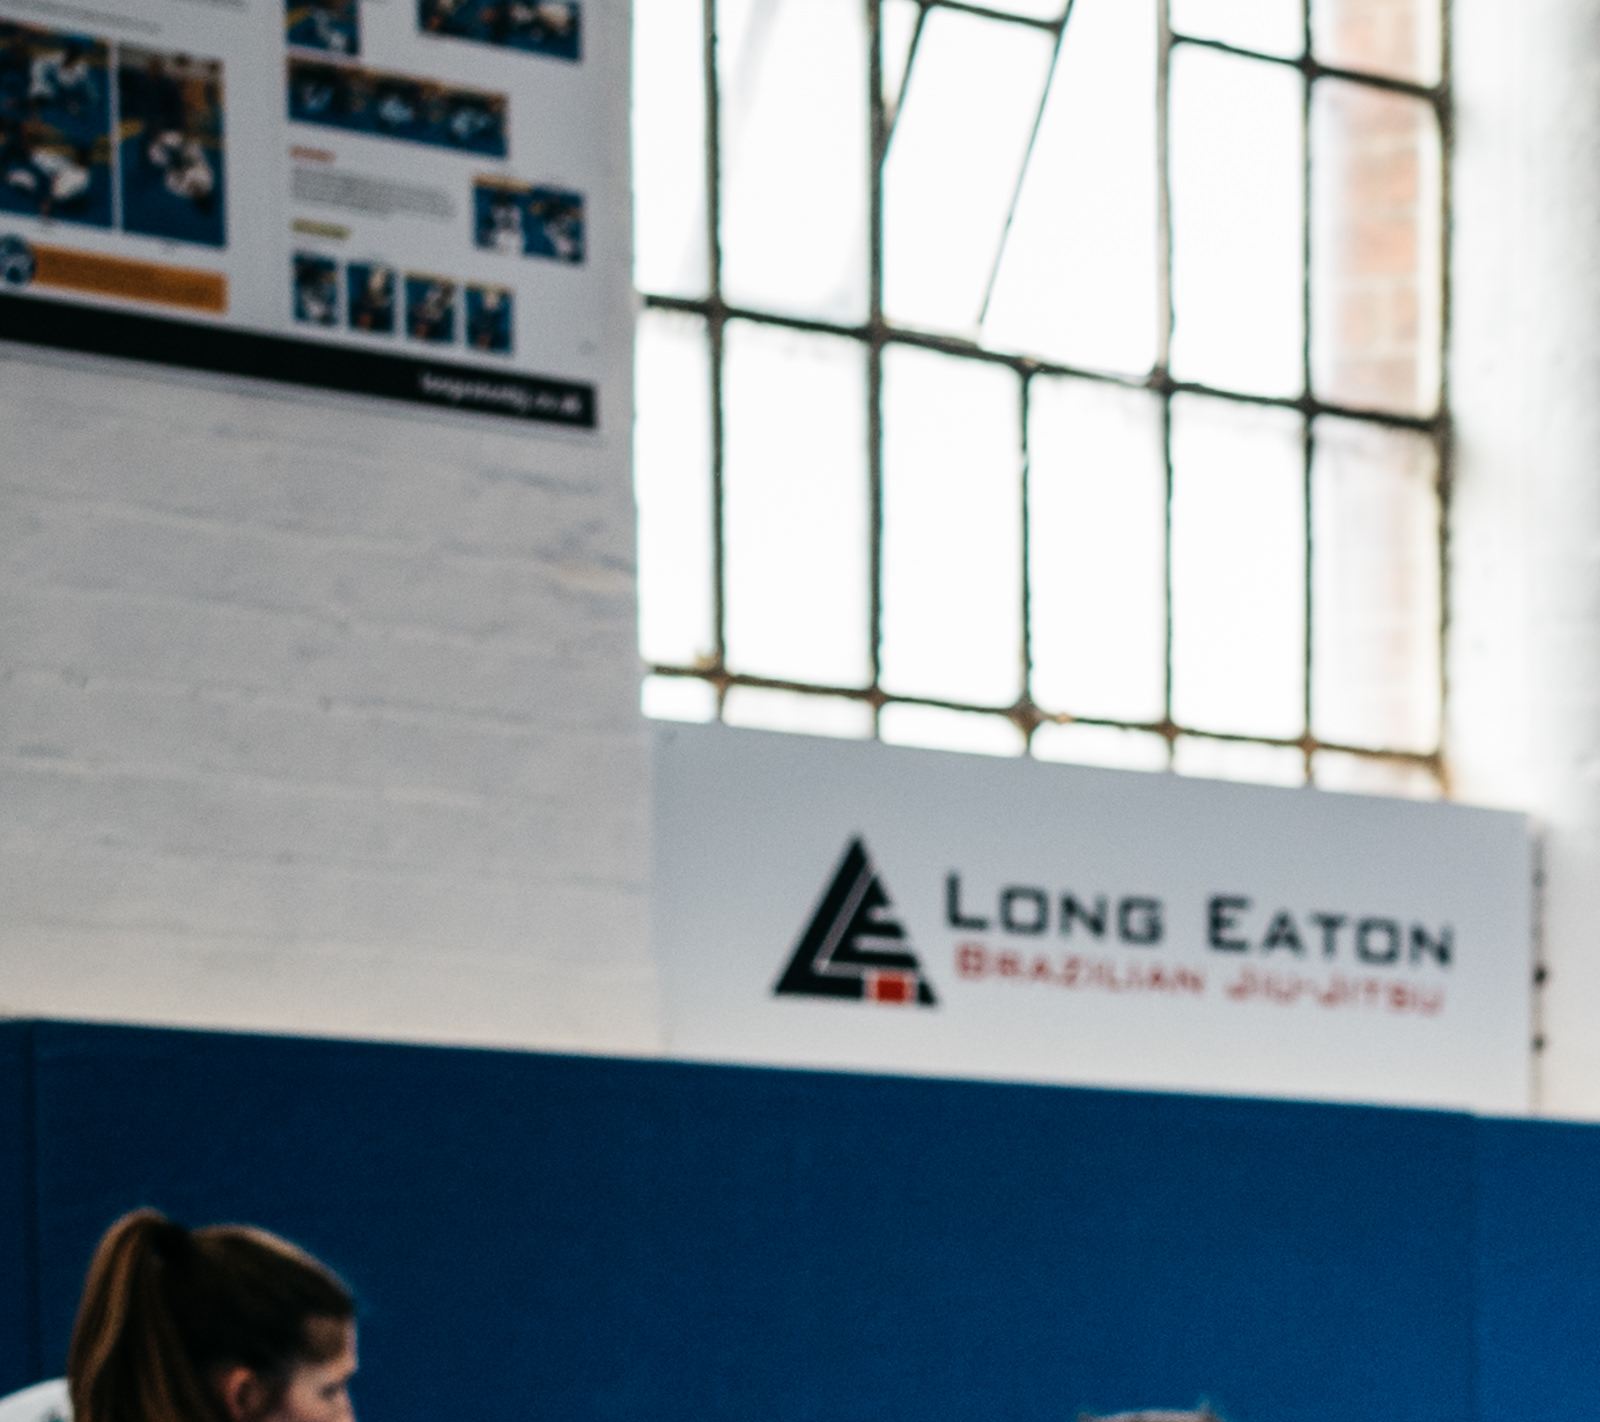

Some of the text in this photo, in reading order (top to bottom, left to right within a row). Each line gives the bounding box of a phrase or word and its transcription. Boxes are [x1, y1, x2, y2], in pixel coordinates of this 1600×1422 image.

[944, 870, 1455, 967] LONG EATON
[955, 940, 1206, 996] BRAZILIAN
